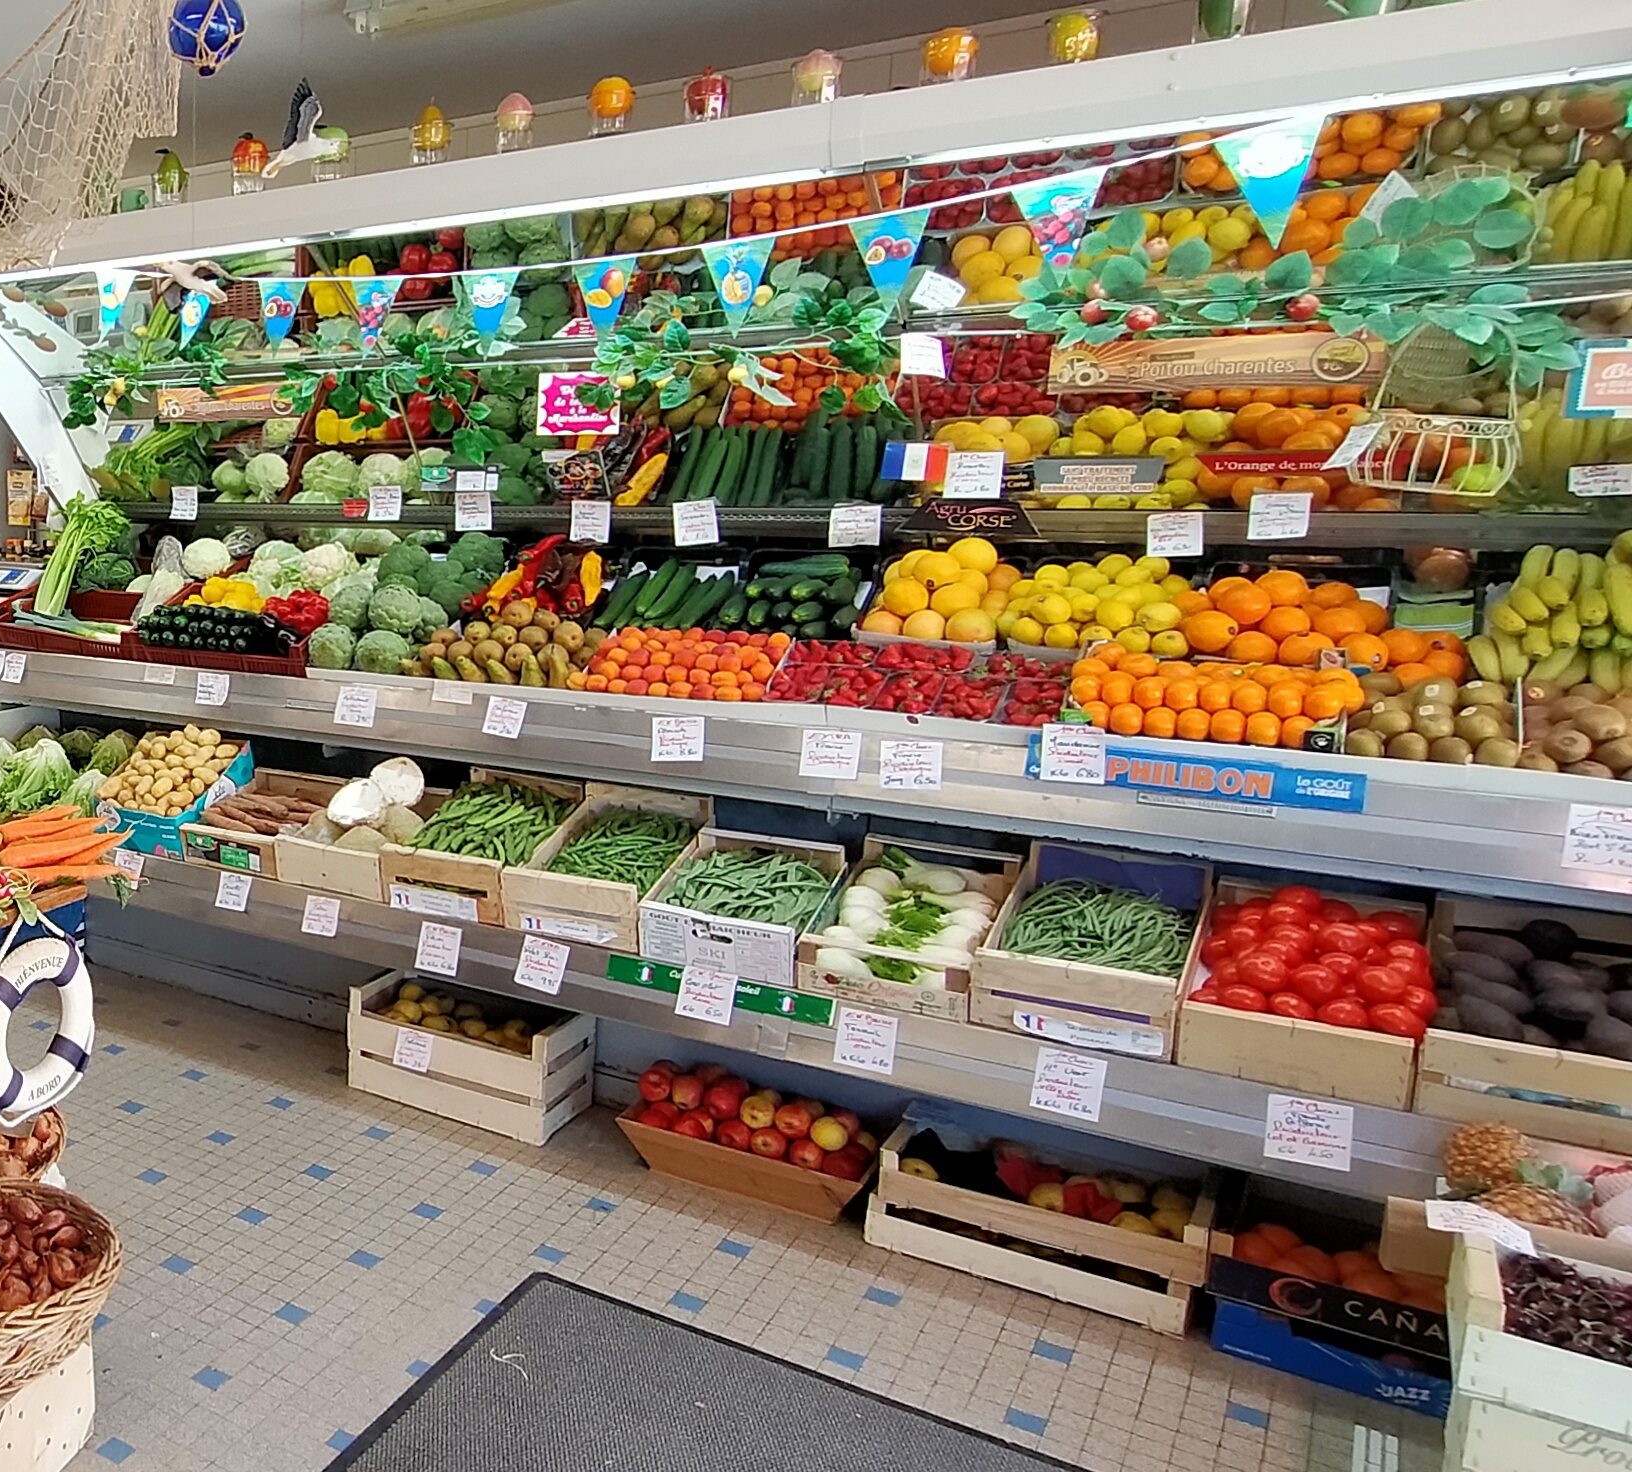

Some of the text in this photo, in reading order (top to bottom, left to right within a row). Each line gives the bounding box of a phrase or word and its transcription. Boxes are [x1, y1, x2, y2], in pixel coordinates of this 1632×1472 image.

[1140, 359, 1295, 376] Poitou Charentes
[1215, 461, 1275, 473] L'Orange
[1278, 460, 1296, 470] de
[926, 502, 967, 520] Agru
[947, 514, 1013, 528] CORSE
[1105, 756, 1275, 800] PHILIBON
[1297, 775, 1353, 790] Le GOÛT
[698, 947, 726, 960] SKI
[14, 955, 65, 990] BIENVENUE
[736, 985, 761, 996] soleil
[36, 1074, 61, 1100] BORD
[1344, 1301, 1445, 1343] CAÑA
[1383, 1385, 1431, 1402] JAZZ
